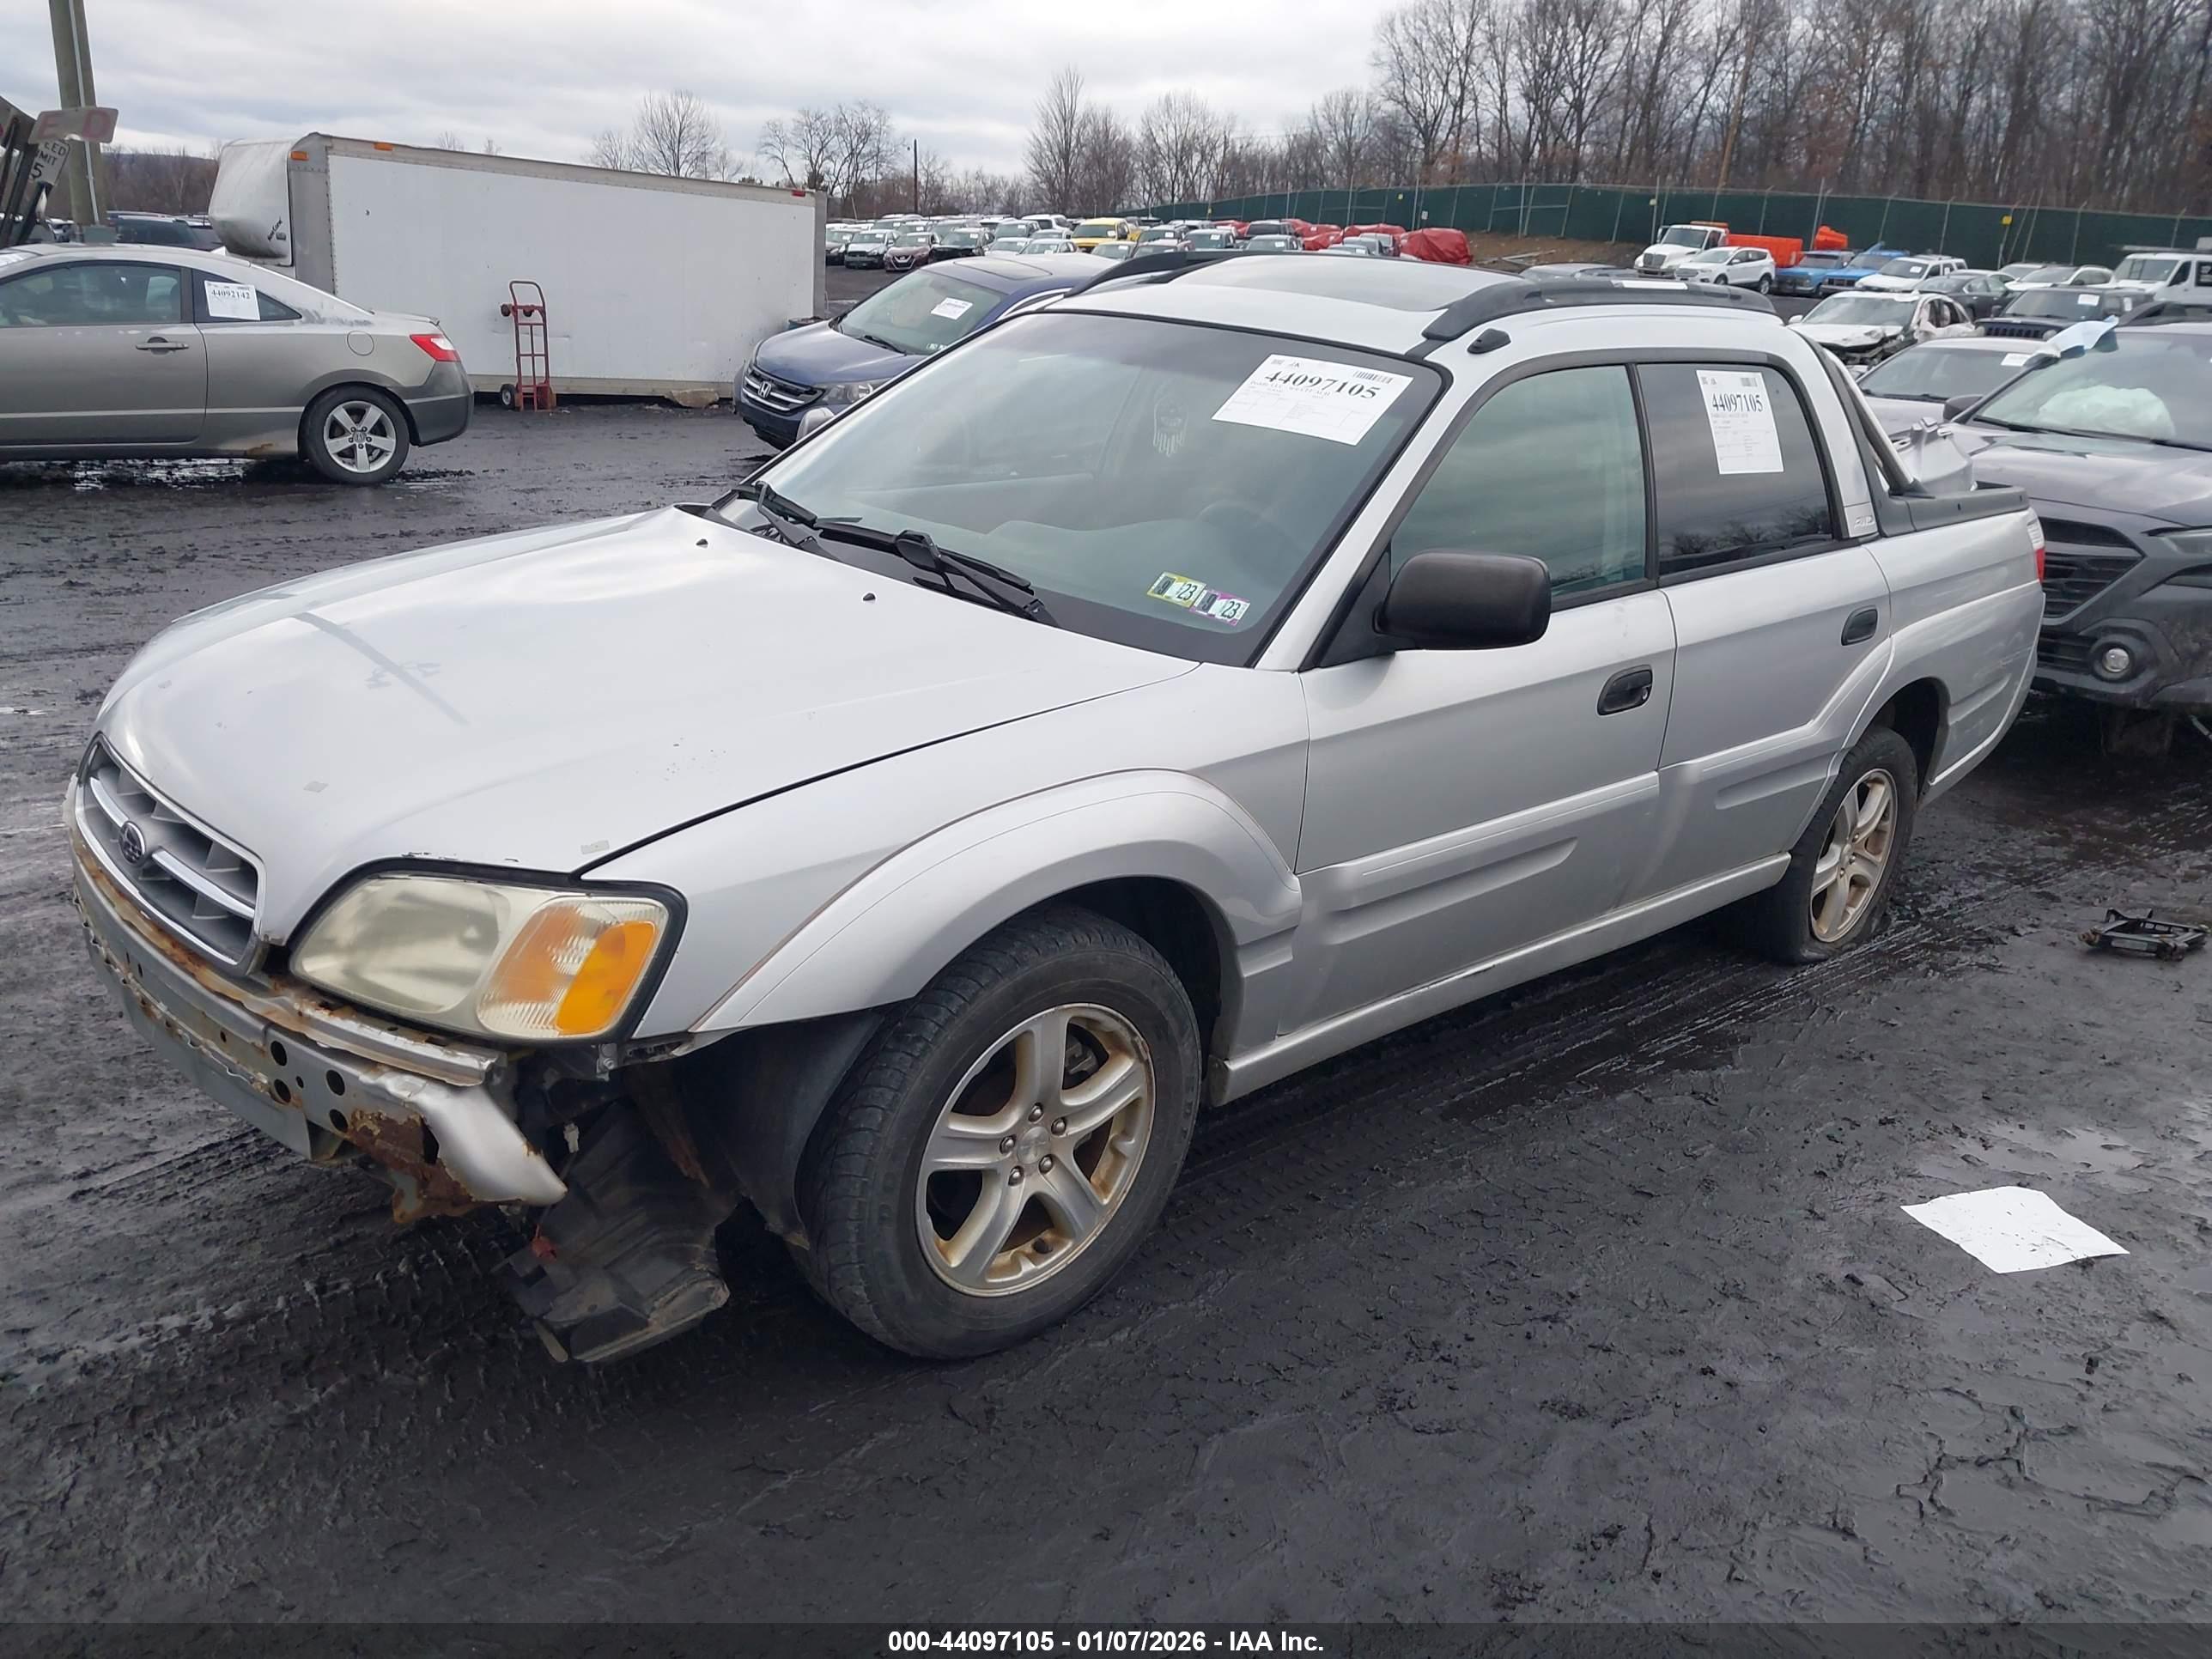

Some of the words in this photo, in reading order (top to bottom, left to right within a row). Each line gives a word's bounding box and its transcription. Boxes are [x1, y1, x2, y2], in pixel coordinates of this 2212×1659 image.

[38, 150, 57, 166] MIT
[31, 162, 45, 179] 5
[1265, 370, 1381, 399] 44097105
[1712, 393, 1764, 412] 44097105
[1221, 600, 1242, 619] 23
